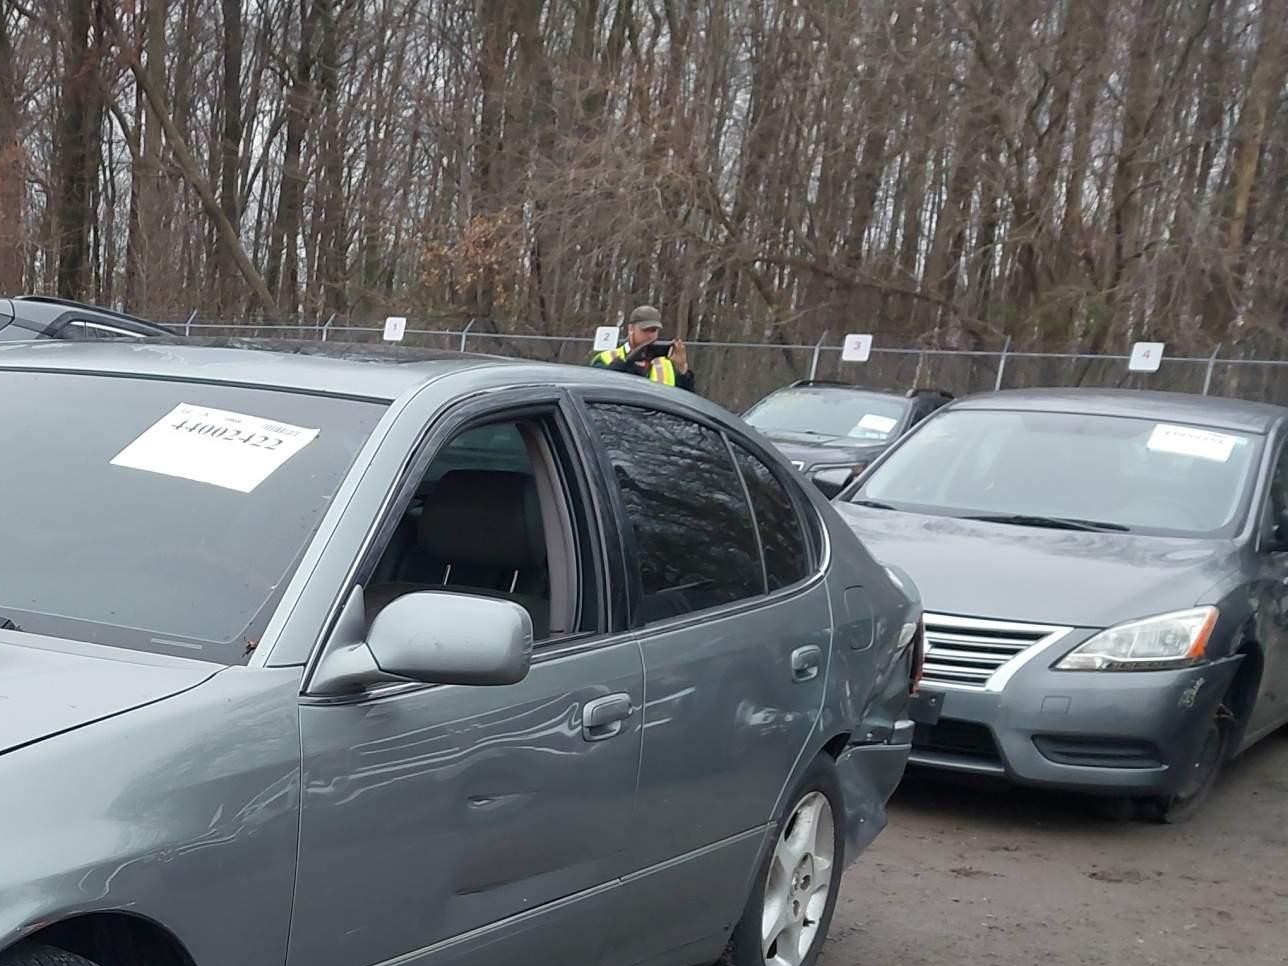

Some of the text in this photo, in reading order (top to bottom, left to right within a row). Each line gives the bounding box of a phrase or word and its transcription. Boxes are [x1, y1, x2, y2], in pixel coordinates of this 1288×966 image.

[603, 332, 610, 341] 2
[1142, 349, 1151, 360] 4
[171, 420, 283, 450] 44002422
